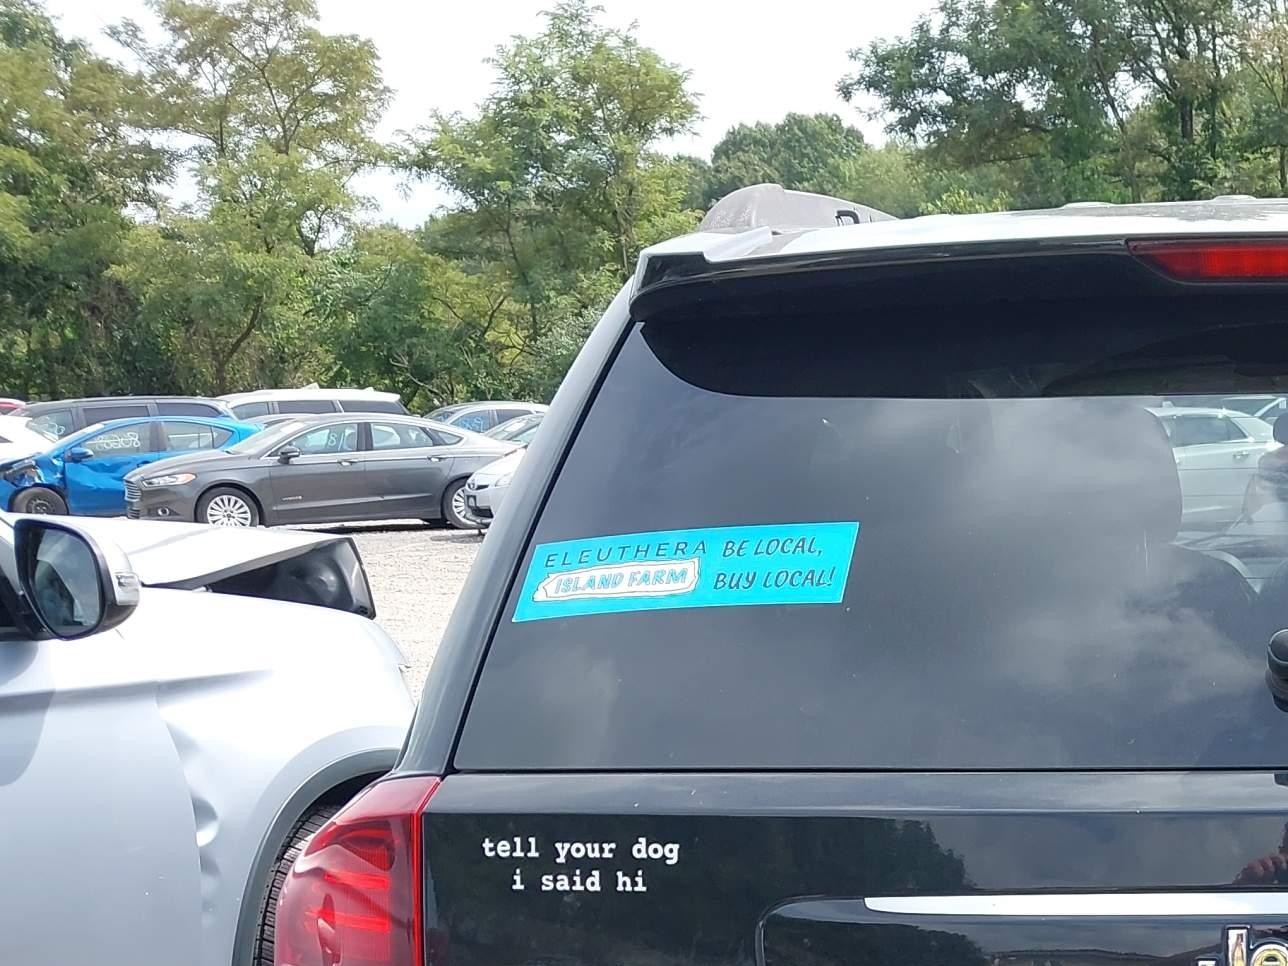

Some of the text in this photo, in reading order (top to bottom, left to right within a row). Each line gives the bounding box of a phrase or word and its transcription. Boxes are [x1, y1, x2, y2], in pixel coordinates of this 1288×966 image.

[545, 539, 707, 568] ELEUTHERA
[722, 536, 823, 557] BE LOCAL,
[554, 567, 689, 594] ISLAND FARM
[713, 566, 836, 590] BUY LOCAL!
[482, 837, 680, 865] tell your dog
[511, 868, 647, 892] i said hi
